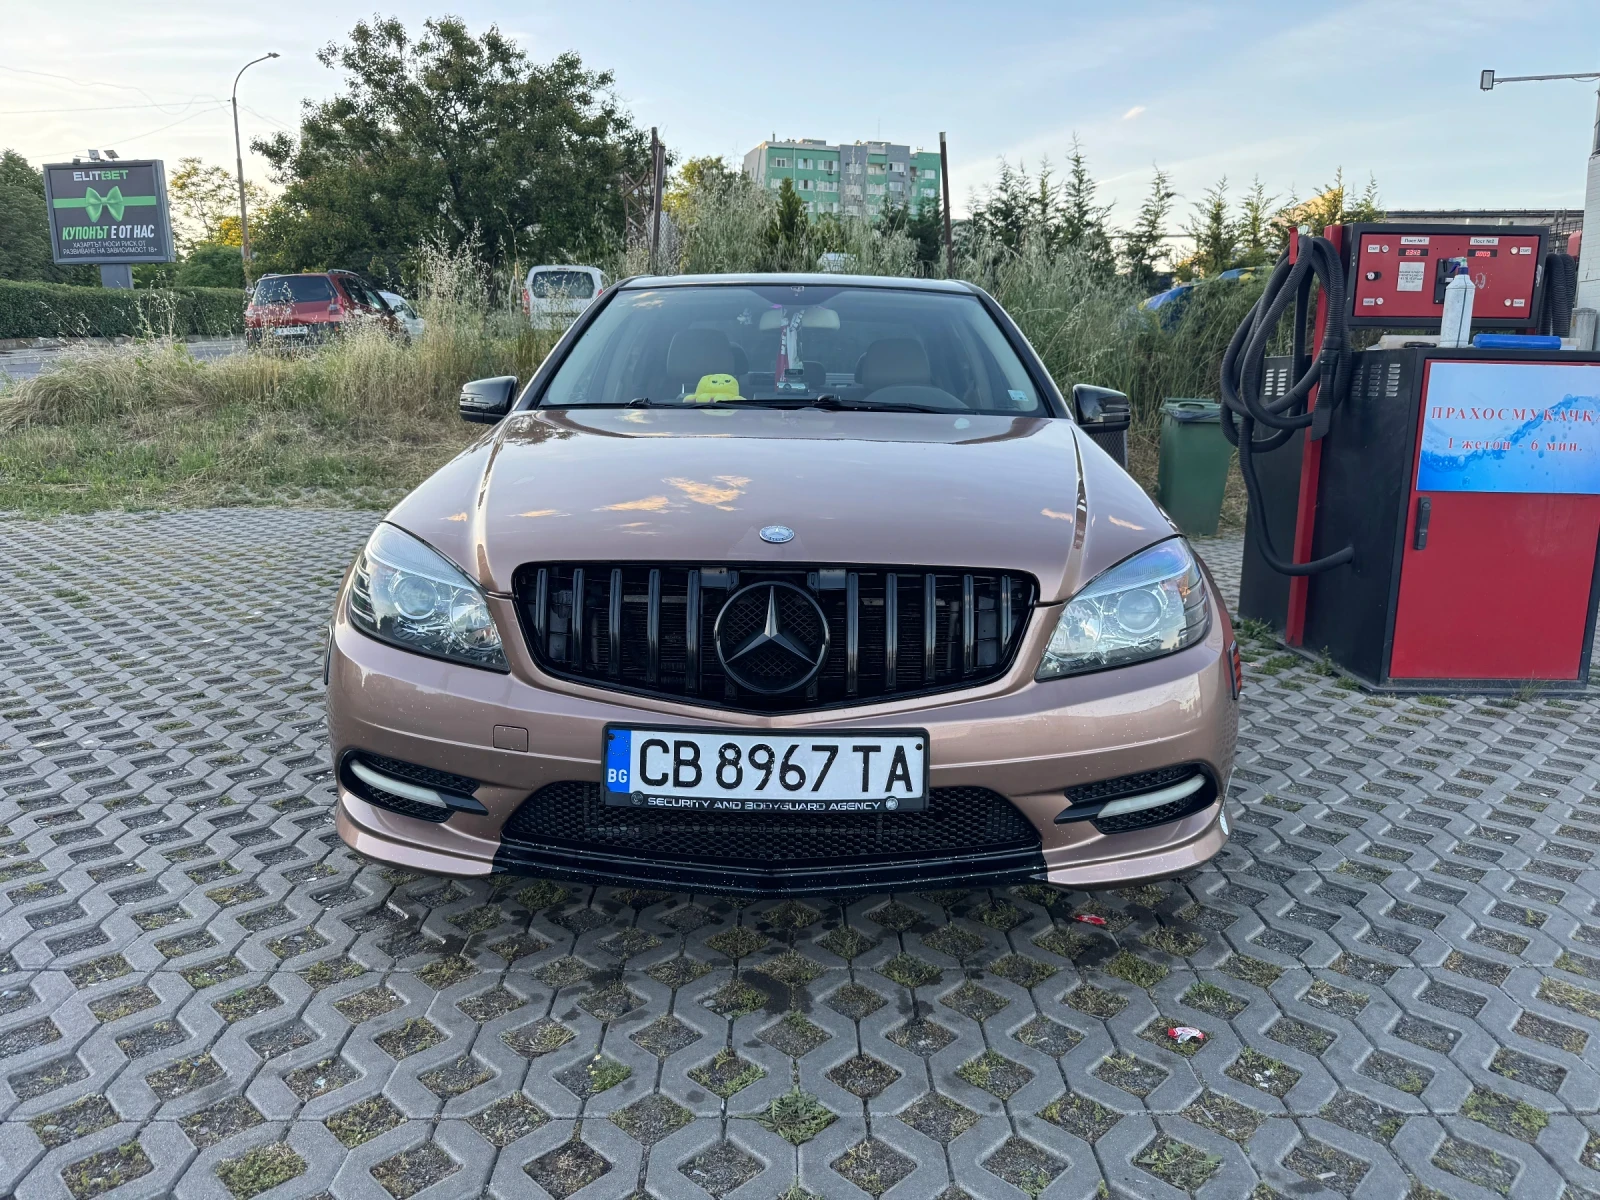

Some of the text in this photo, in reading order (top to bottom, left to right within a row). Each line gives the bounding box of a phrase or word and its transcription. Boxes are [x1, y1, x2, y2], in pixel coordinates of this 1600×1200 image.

[73, 170, 129, 181] ELITBET
[62, 224, 155, 240] КУПОНЪТ Е ОТ НАС
[106, 246, 147, 254] ЗАВИСИМОСТ
[1431, 406, 1600, 421] ПРАХОСМУКАЧК
[1448, 437, 1453, 449] 1
[1462, 439, 1511, 450] жетон
[1530, 438, 1539, 451] 6
[1545, 441, 1583, 452] мин.
[639, 738, 913, 793] CB 8967 TA
[607, 767, 628, 783] BG
[647, 797, 881, 812] SECURITY AND BODYGUARD AGENCY
